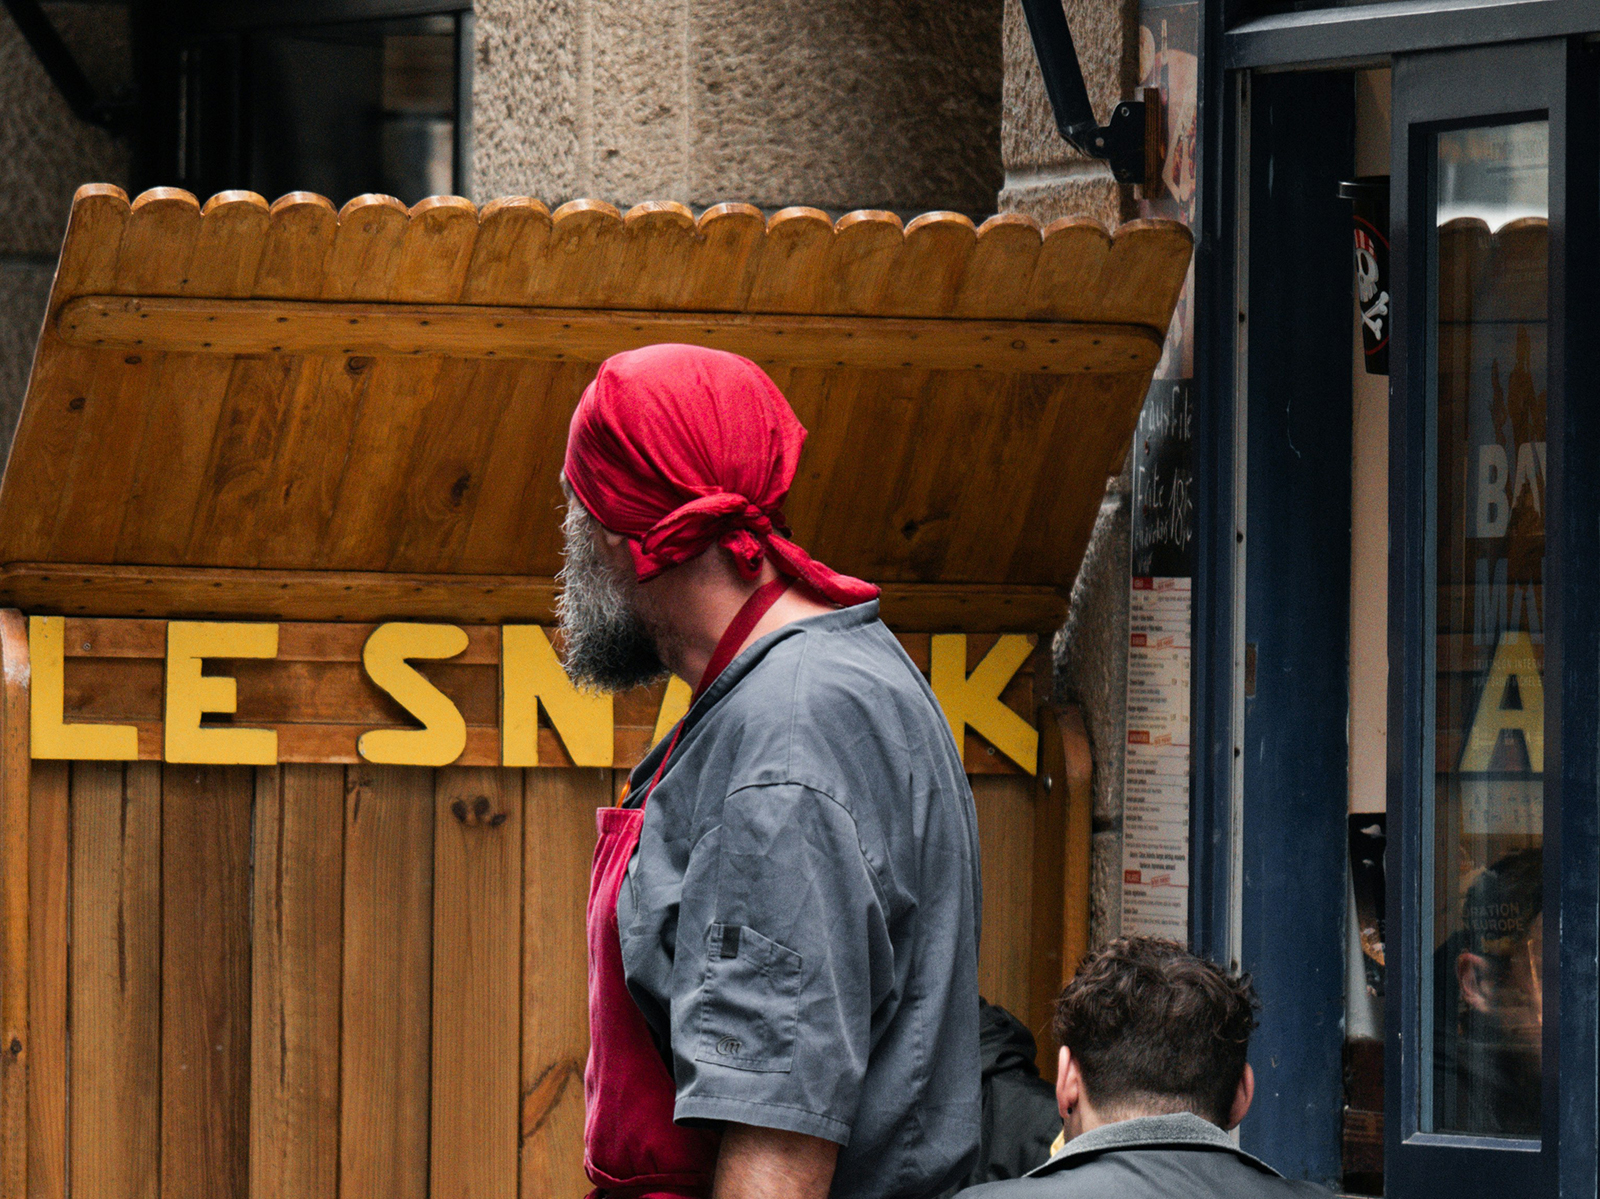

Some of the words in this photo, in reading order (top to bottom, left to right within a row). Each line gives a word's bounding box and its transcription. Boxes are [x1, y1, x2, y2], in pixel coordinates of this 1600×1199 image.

[1475, 442, 1547, 538] BA
[30, 615, 279, 766] LE
[358, 621, 1039, 777] SNK
